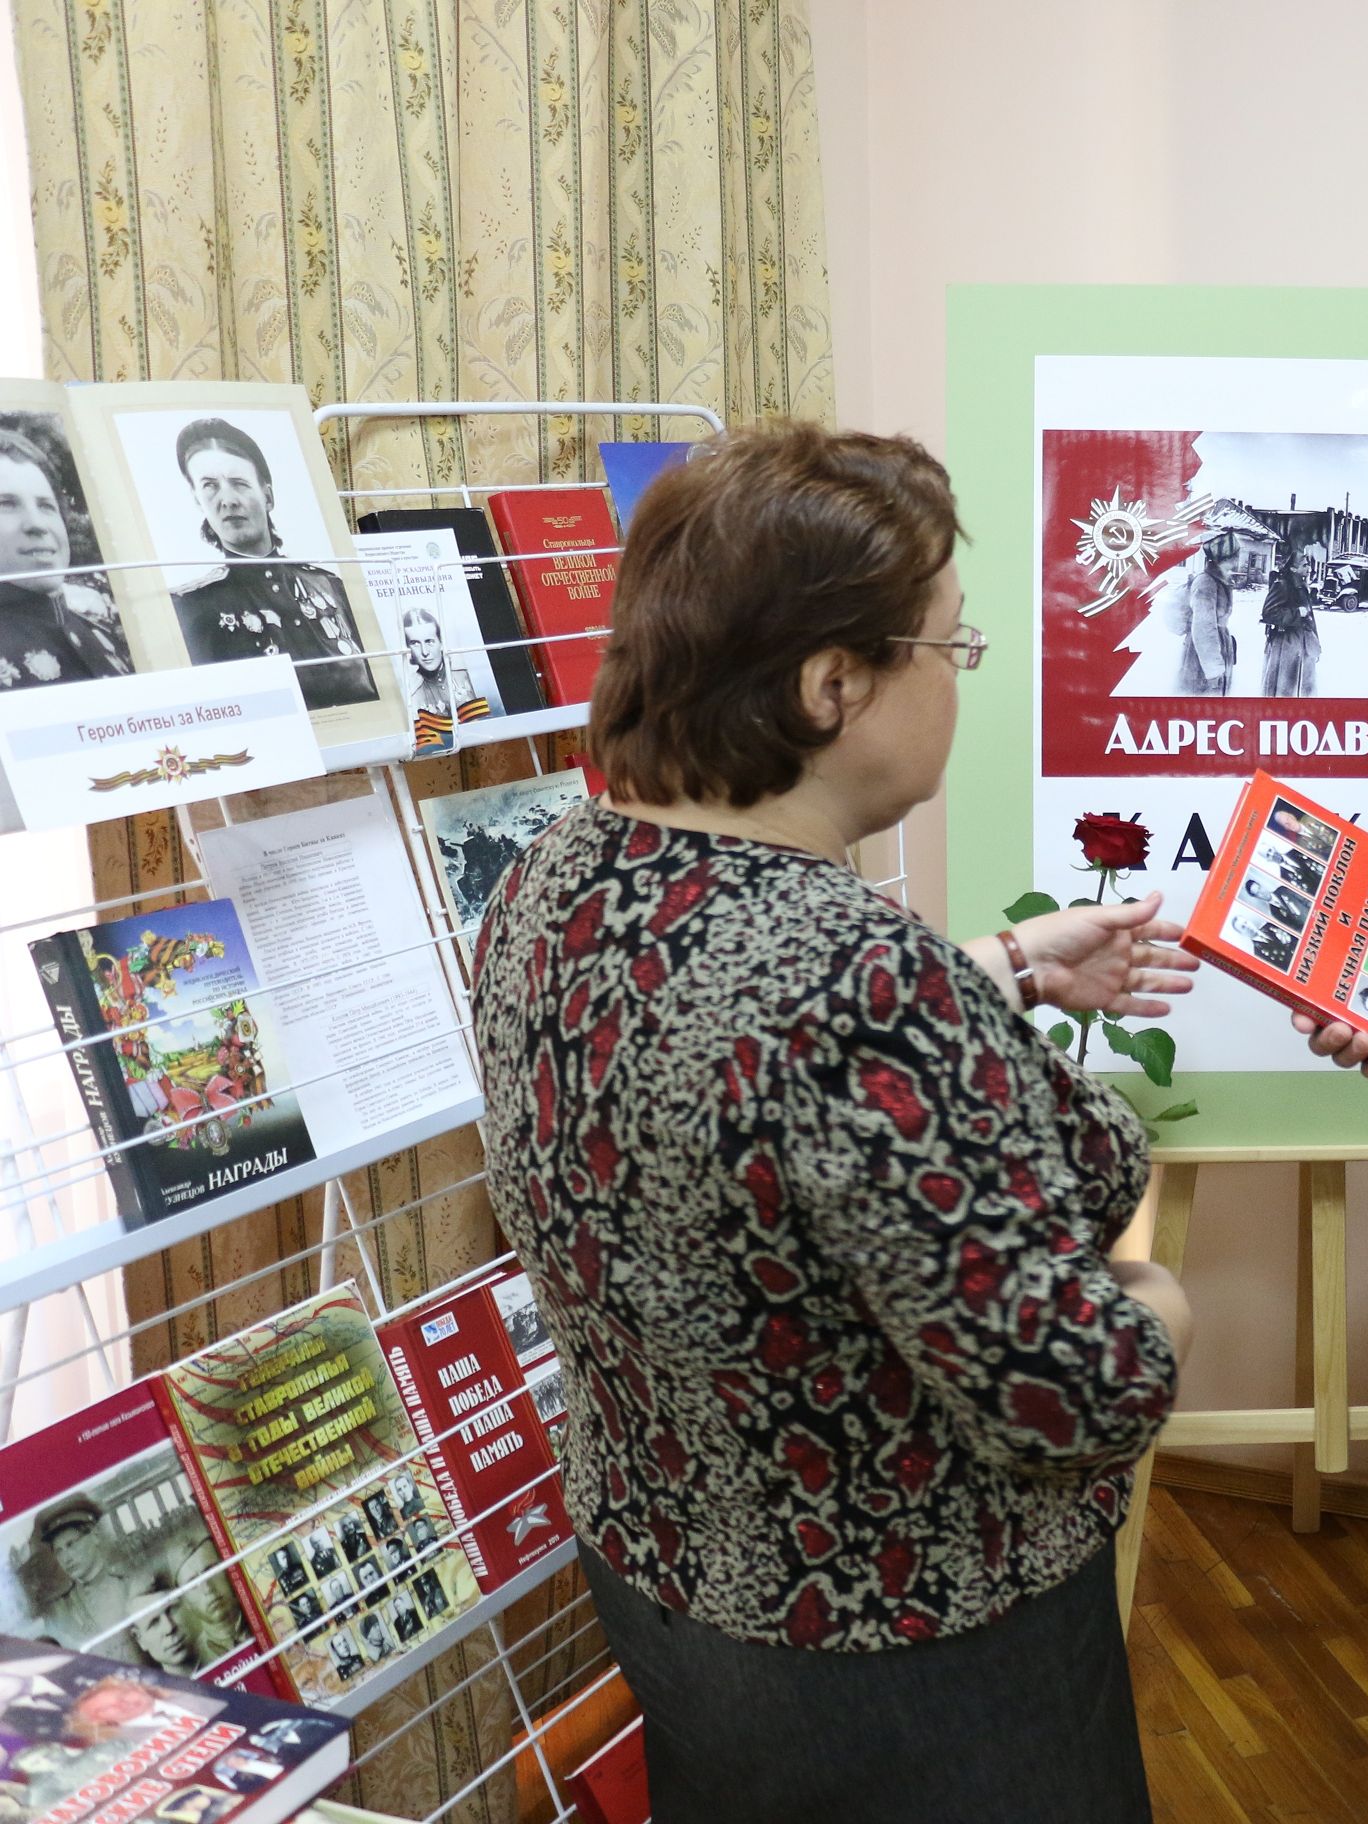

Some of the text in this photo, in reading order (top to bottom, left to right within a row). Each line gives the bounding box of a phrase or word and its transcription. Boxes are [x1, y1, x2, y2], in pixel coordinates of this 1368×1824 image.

[543, 538, 595, 550] Ставропольцы
[553, 554, 597, 570] ВЕЛИКОЙ
[541, 564, 617, 586] ОТЕЧЕСТВЕННОЙ
[567, 584, 601, 600] ВОЙНЕ
[76, 704, 243, 743] Герои битвы за Кавказ
[1104, 713, 1245, 756] АДРЕС
[1295, 835, 1358, 985] НИЗКИЙ ПОКЛОН
[1338, 910, 1353, 928] И
[1333, 933, 1368, 1003] ВЕЧНАЯ
[208, 1147, 289, 1191] НАГРАДЫ
[235, 1353, 349, 1425] СТАВРОПОЛЬЯ
[389, 1346, 422, 1407] ПАМЯТЬ
[437, 1353, 482, 1389] НАША
[246, 1411, 299, 1452] ГОДЫ
[302, 1366, 375, 1423] ВЕЛИКОЙ
[448, 1375, 503, 1417] ПОБЕДА
[248, 1396, 377, 1486] ОТЕЧЕСТВЕННОЙ
[473, 1402, 515, 1438] НАША
[294, 1443, 355, 1490] ВОЙНЫ
[430, 1454, 447, 1470] И
[469, 1430, 524, 1473] ПАМЯТЬ
[462, 1530, 489, 1578] НАША
